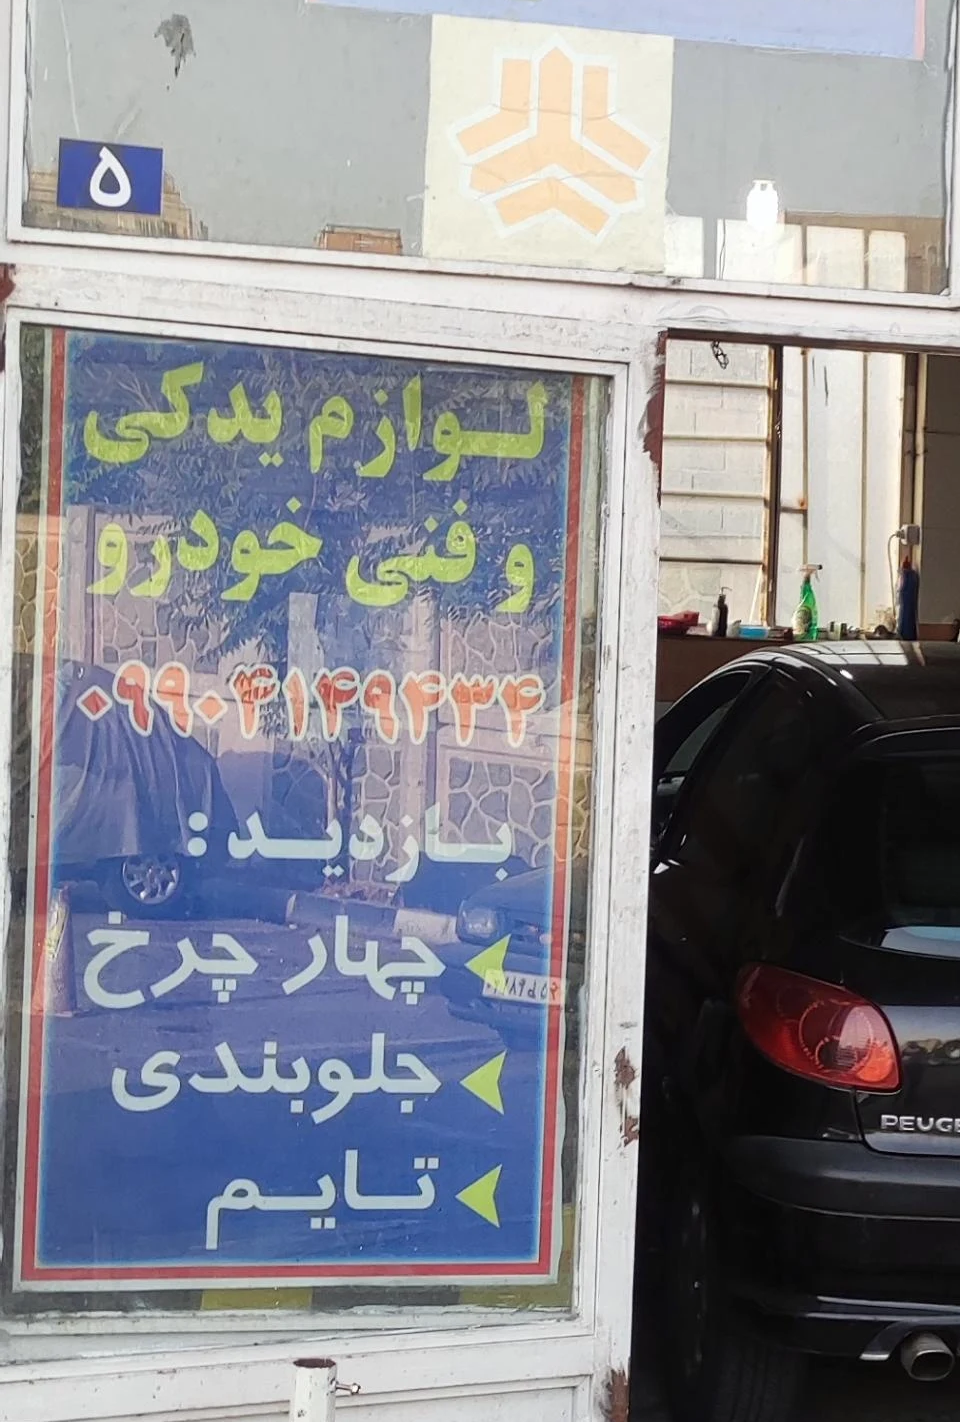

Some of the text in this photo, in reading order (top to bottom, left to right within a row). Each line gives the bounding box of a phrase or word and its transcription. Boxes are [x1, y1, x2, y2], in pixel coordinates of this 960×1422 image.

[82, 361, 551, 482] لوازم یدکی
[86, 497, 536, 613] و فنی خودرو
[83, 911, 446, 1009] چهار چرخ
[111, 1033, 441, 1124] جلوبندی
[205, 1150, 439, 1250] تایم
